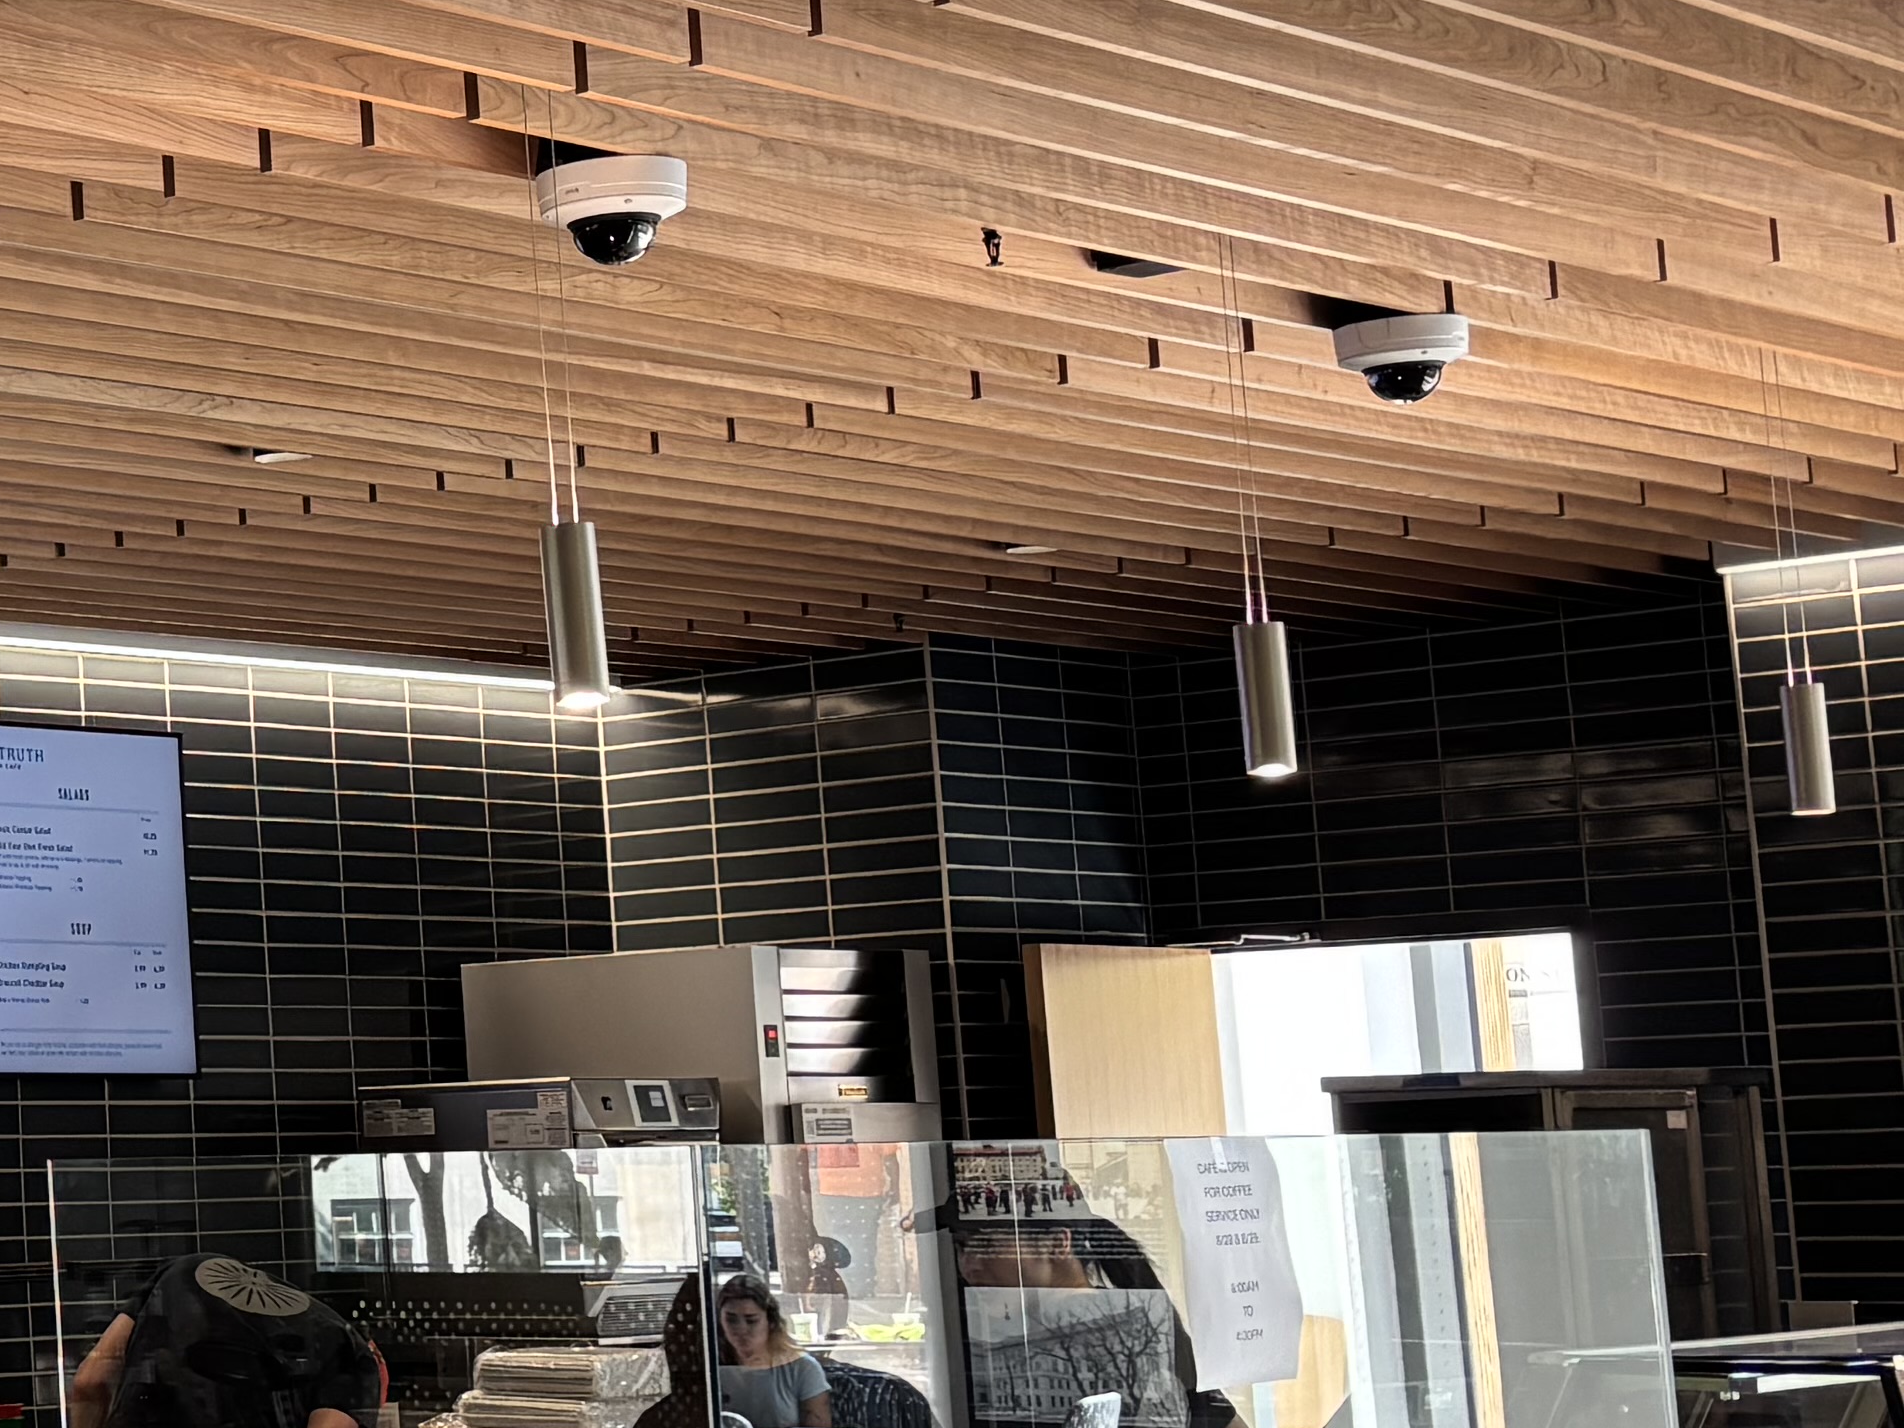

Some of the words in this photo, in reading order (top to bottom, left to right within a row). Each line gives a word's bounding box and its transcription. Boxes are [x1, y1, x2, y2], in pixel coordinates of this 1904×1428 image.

[1227, 1161, 1250, 1173] OPEN
[1222, 1184, 1252, 1197] COFFEE
[1206, 1210, 1239, 1222] SERVICE
[1244, 1305, 1253, 1317] TO
